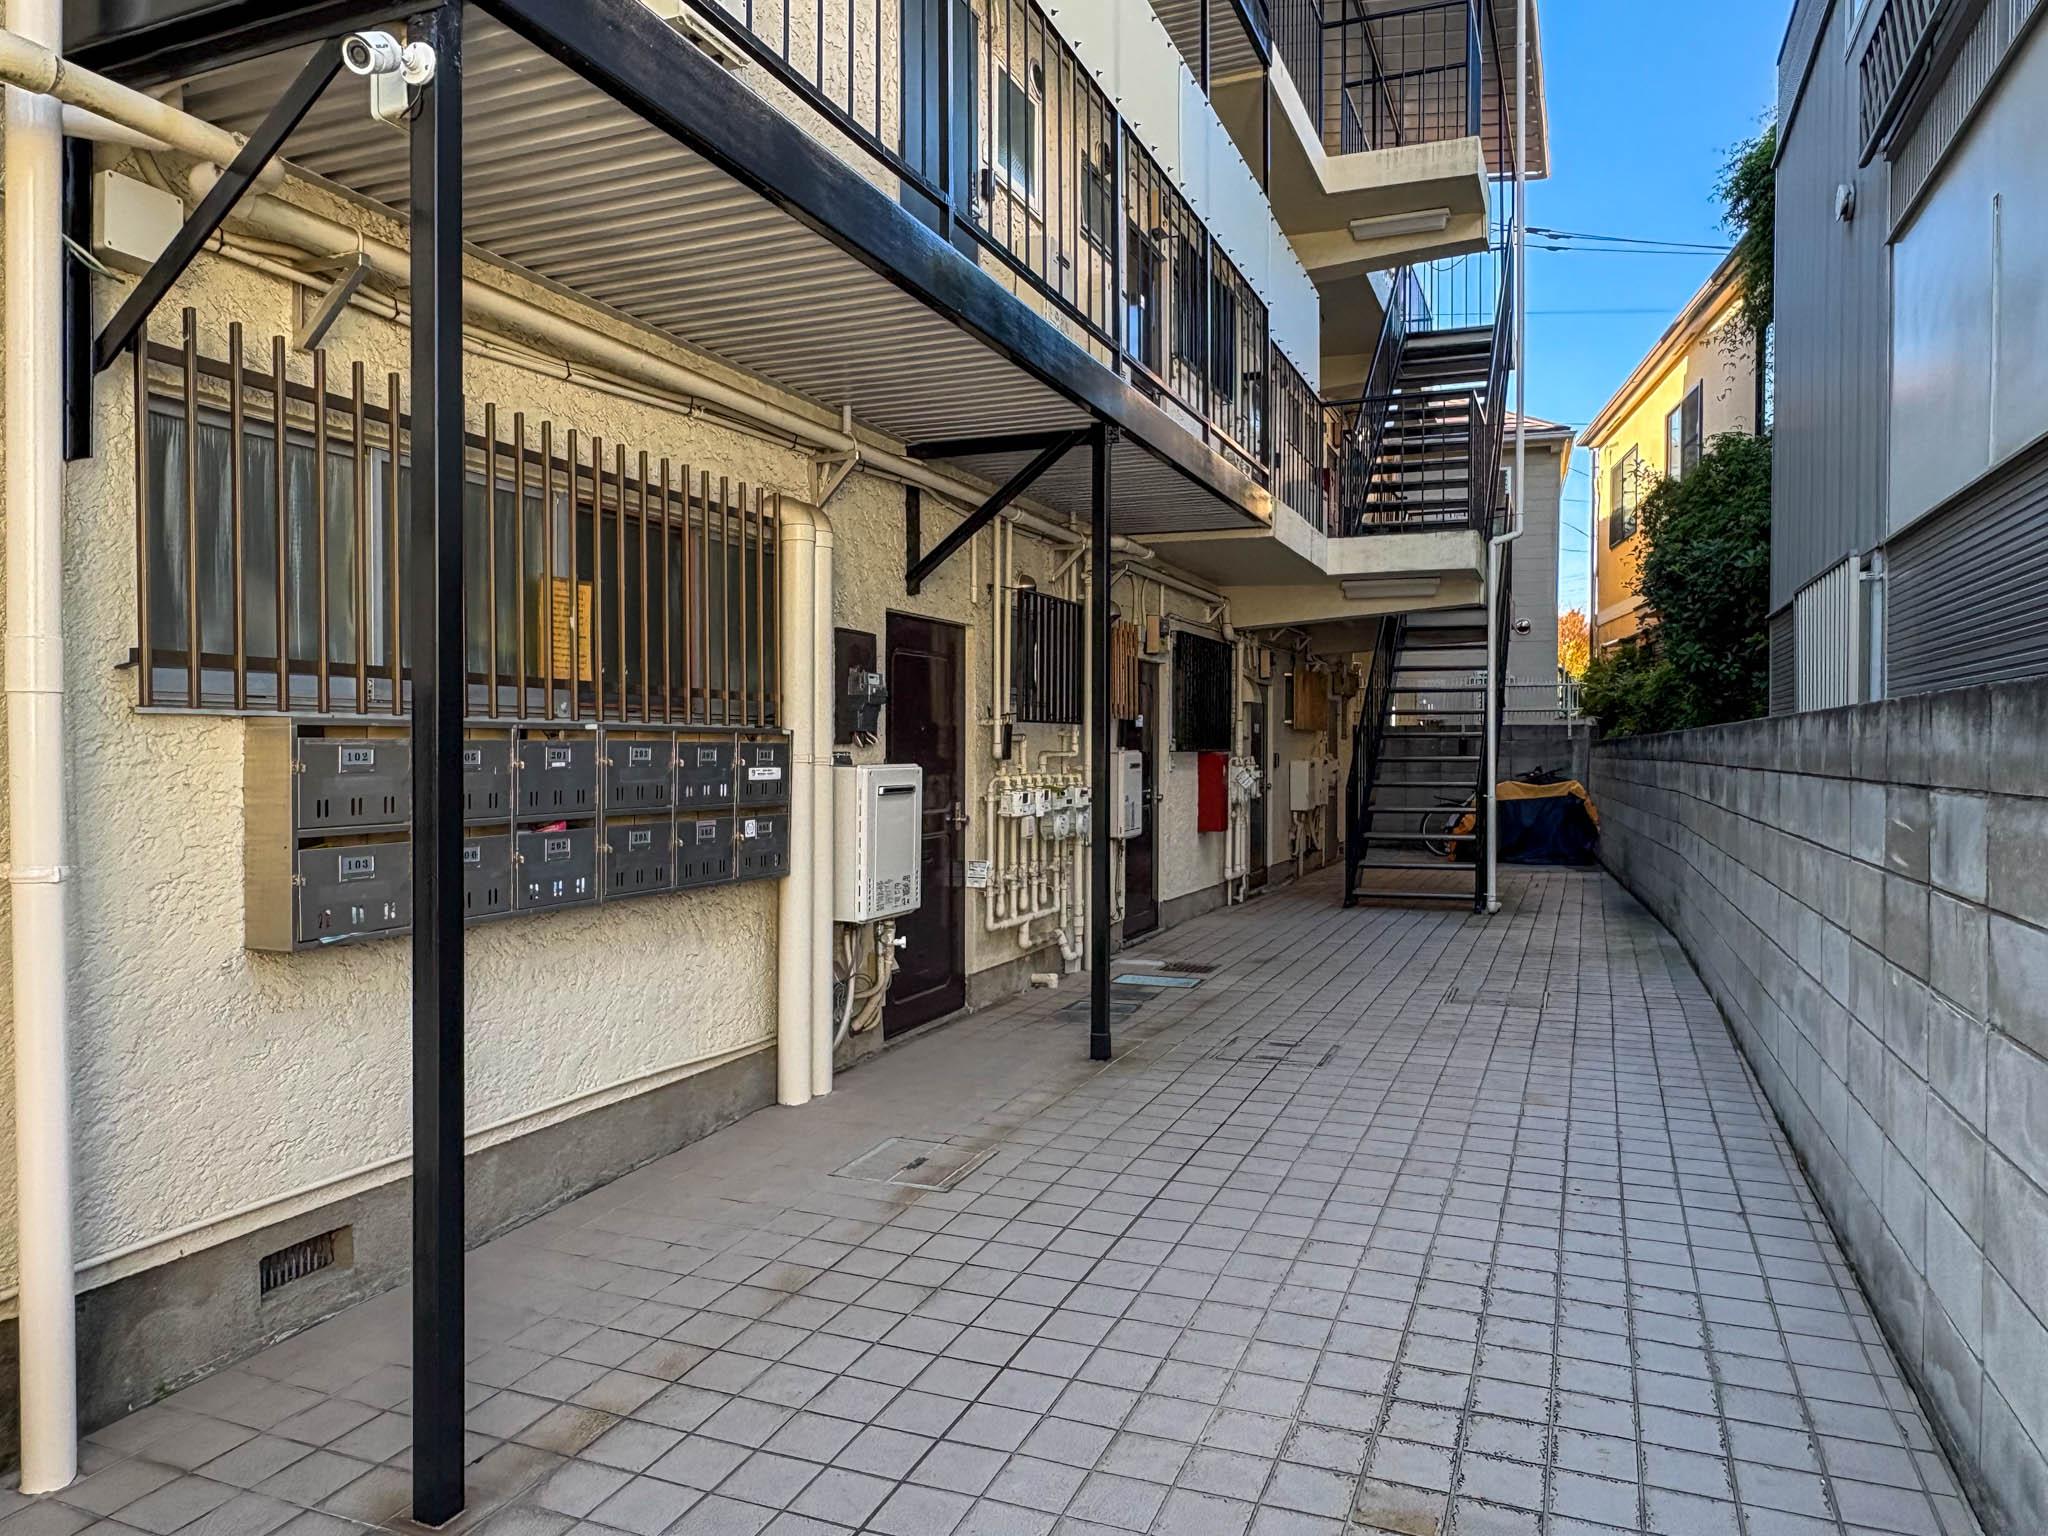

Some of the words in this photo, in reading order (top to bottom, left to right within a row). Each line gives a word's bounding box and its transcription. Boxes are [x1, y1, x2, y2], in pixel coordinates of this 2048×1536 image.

[347, 752, 368, 762] 102
[464, 752, 477, 762] 05
[348, 859, 369, 870] 103
